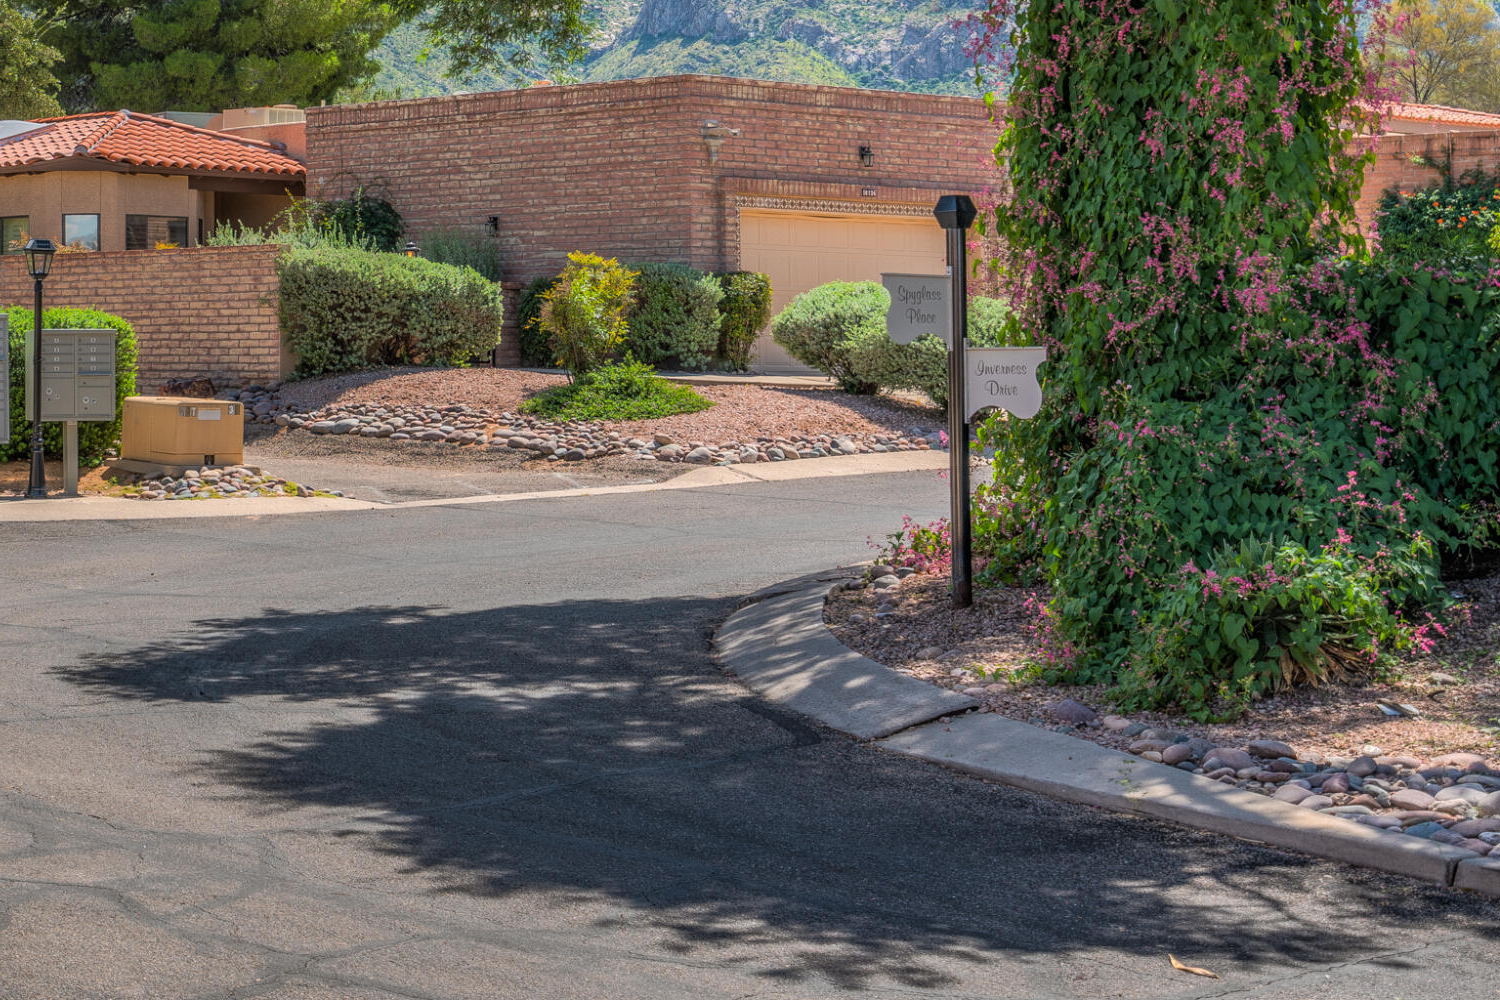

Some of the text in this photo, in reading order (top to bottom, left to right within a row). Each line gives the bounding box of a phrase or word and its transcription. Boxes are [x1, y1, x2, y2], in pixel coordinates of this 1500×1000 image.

[898, 285, 941, 305] Spyglass
[905, 307, 936, 325] Place
[975, 360, 1027, 376] Inverness
[984, 380, 1018, 396] Drive
